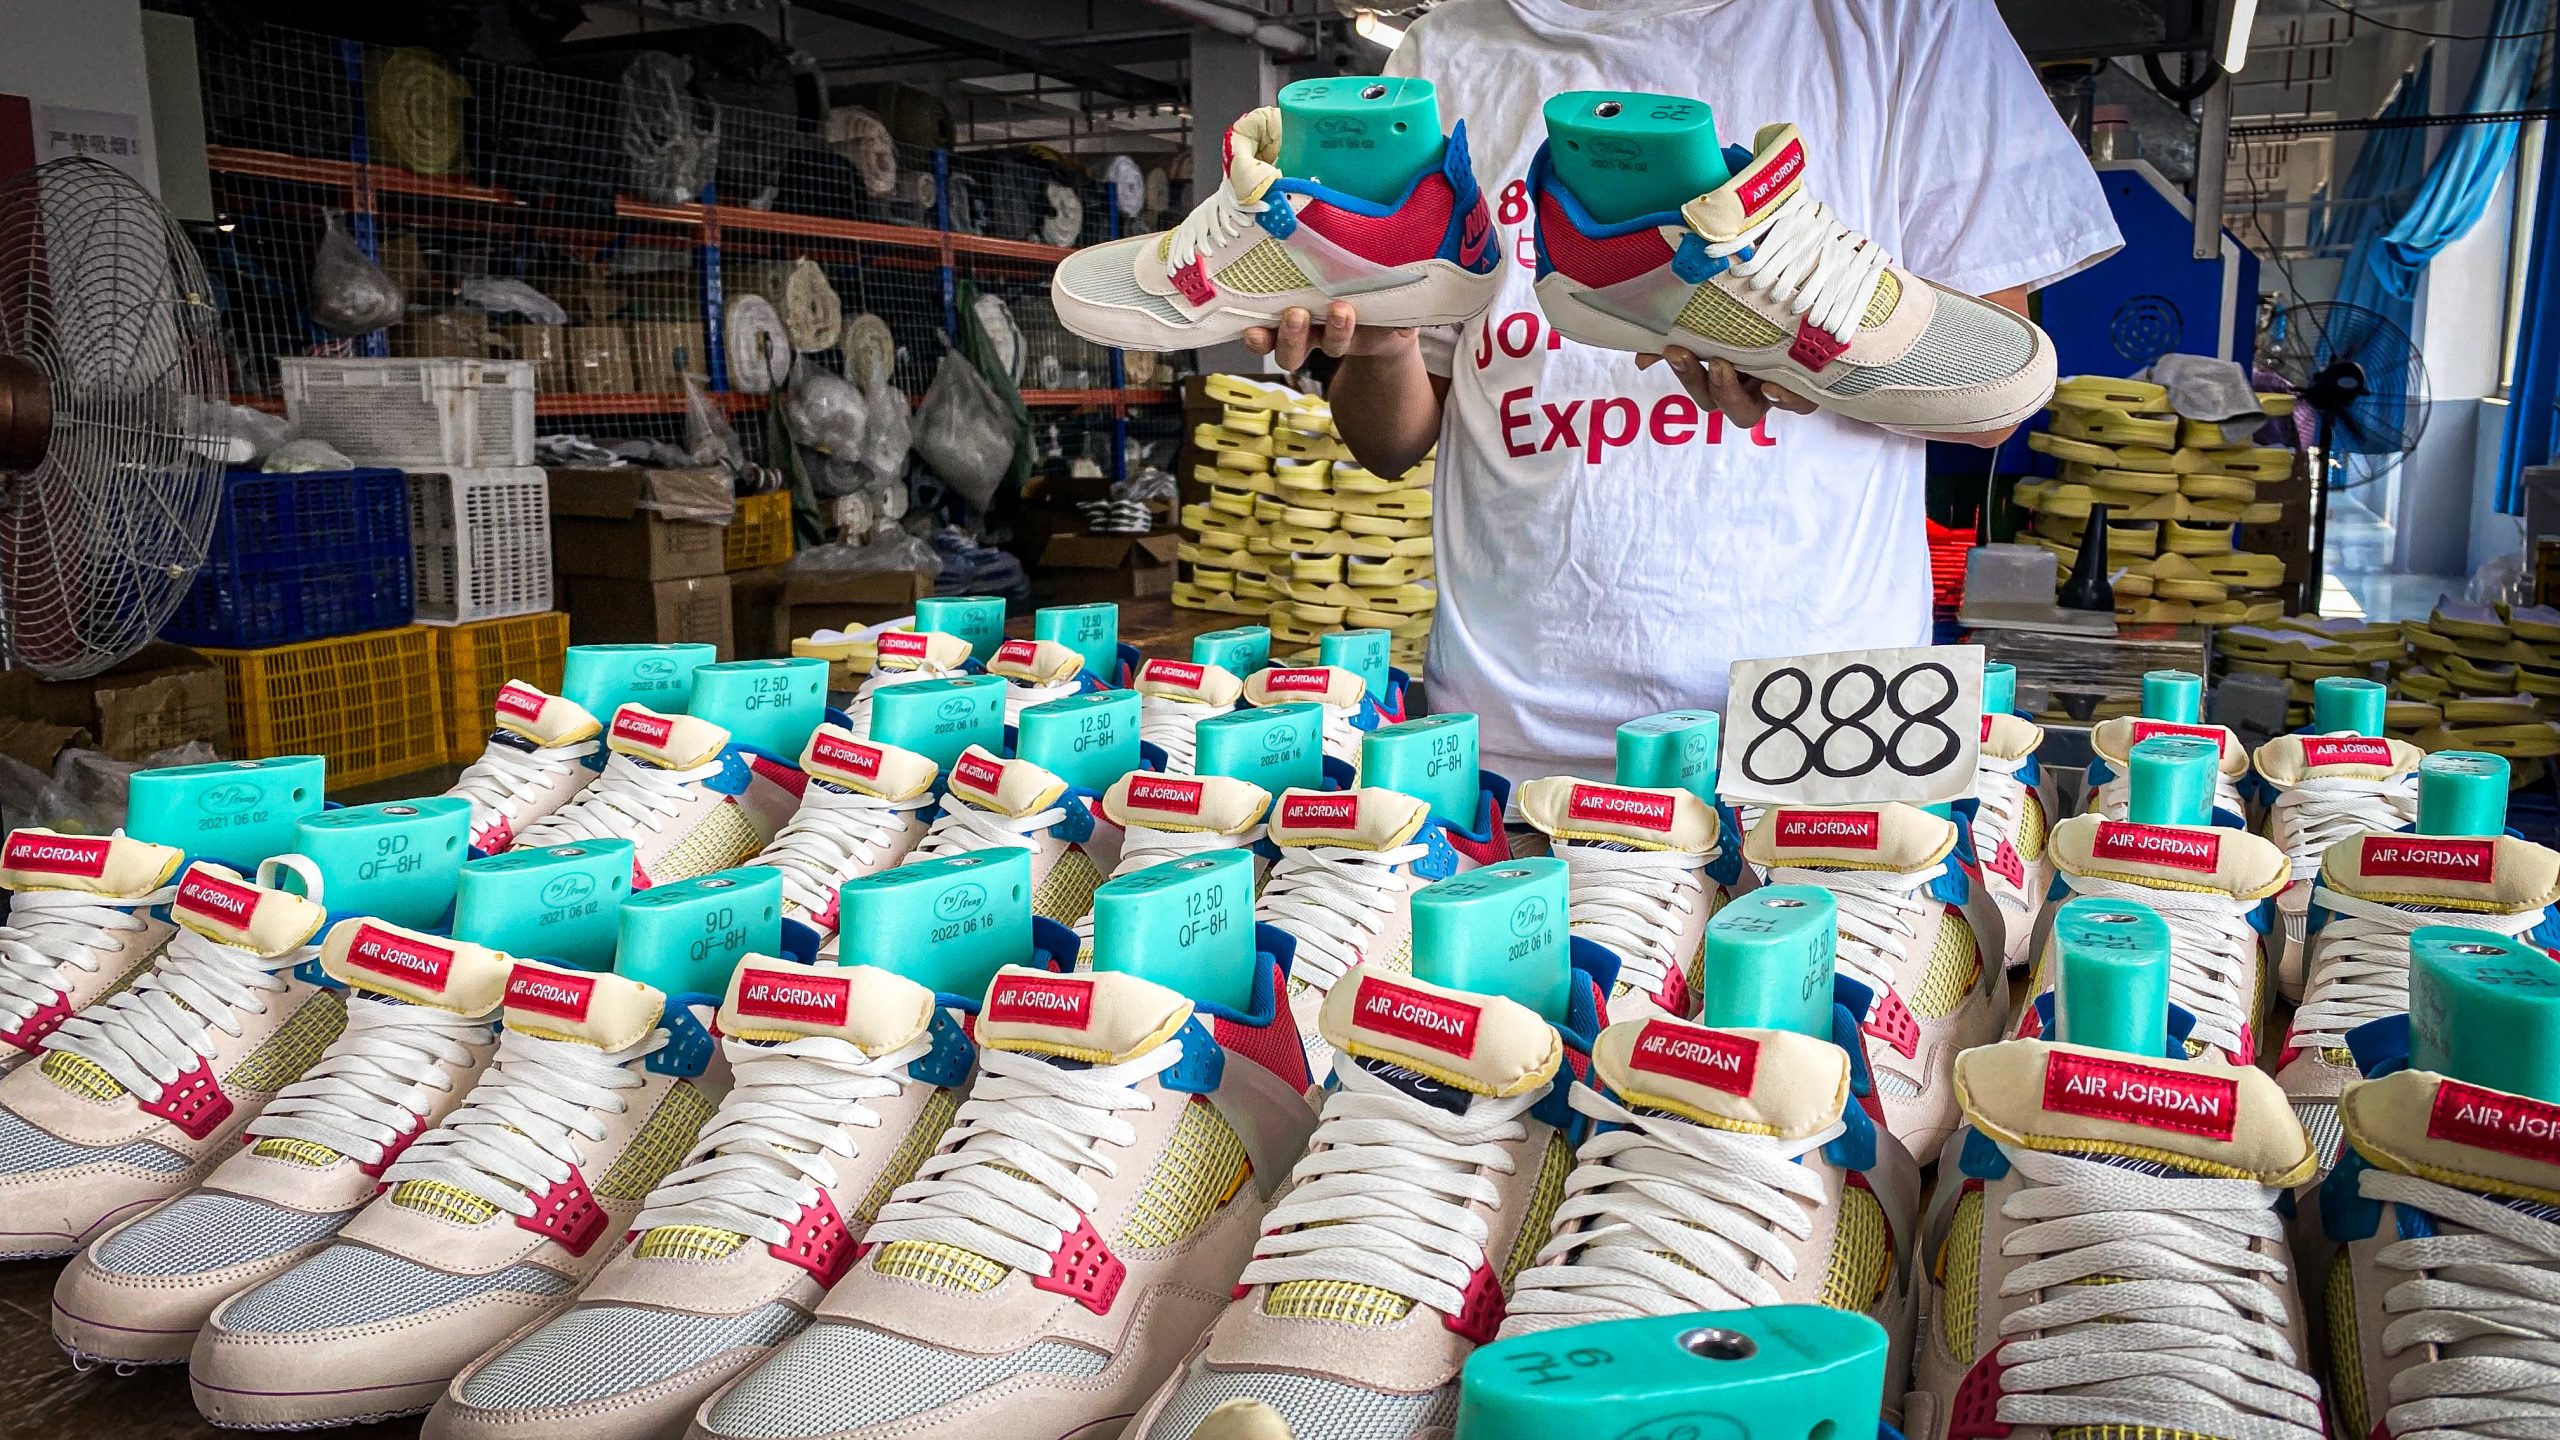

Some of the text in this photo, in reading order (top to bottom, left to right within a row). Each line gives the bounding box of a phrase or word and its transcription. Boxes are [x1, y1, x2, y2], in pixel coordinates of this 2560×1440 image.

[1753, 151, 1802, 203] AIR JORDAN
[885, 639, 921, 650] JORDAN
[752, 676, 789, 693] 12.5D
[1162, 666, 1198, 681] JORDAN
[1285, 674, 1324, 684] JORDAN
[745, 692, 792, 711] QF-8H
[629, 720, 664, 738] JORDAN
[1080, 712, 1111, 733] 12.5D
[1742, 662, 1961, 786] 888
[1073, 729, 1114, 752] QF-8H
[1432, 734, 1459, 757] 12.5D
[2316, 744, 2386, 758] AIR JORDAN
[817, 744, 873, 768] AIR JORDAN
[1427, 753, 1462, 777] QF-8H
[966, 764, 994, 782] JORDAN
[1134, 786, 1194, 803] AIR JORDAN
[1288, 805, 1350, 818] AIR JORDAN
[1580, 796, 1665, 818] AIR JORDAN
[198, 810, 268, 831] 2021 06 02
[1784, 822, 1870, 836] AIR JORDAN
[11, 845, 98, 863] AIR JORDAN
[376, 834, 409, 857] 9D
[2107, 833, 2209, 858] AIR JORDAN
[358, 852, 421, 880] QF-8H
[2371, 849, 2479, 867] AIR JORDAN
[183, 883, 246, 914] AIR JORDAN
[1185, 884, 1223, 918] 12.5D
[539, 901, 598, 927] 2021 06 02
[705, 907, 733, 934] 9D
[931, 913, 993, 943] 2022 06 16
[1179, 909, 1227, 947] QF-8H
[690, 926, 747, 962] QF-8H
[1508, 928, 1552, 962] 2022 06 16
[358, 940, 439, 975] AIR JORDAN
[511, 979, 580, 1006] AIR JORDAN
[746, 984, 837, 1009] AIR JORDAN
[996, 990, 1080, 1012] AIR JORDAN
[1365, 996, 1465, 1037] AIR JORDAN
[1641, 1036, 1742, 1074] AIR JORDAN
[2065, 1074, 2220, 1117] AIR JORDAN
[2454, 1103, 2503, 1129] AIR
